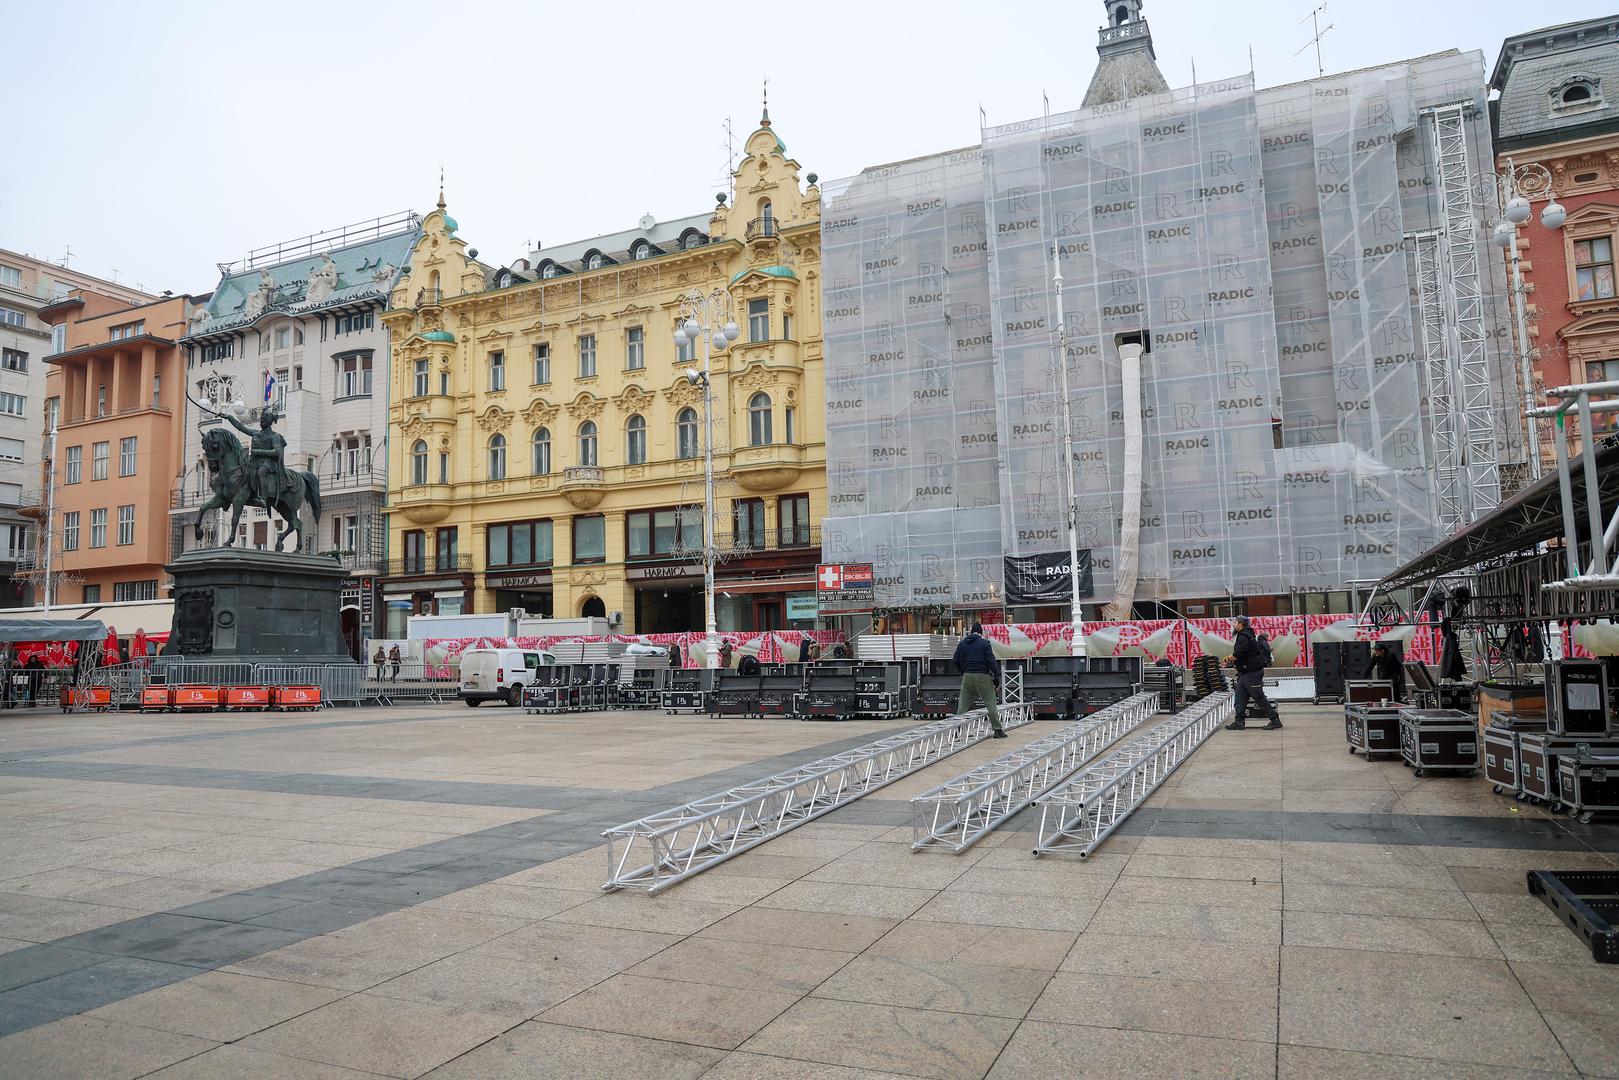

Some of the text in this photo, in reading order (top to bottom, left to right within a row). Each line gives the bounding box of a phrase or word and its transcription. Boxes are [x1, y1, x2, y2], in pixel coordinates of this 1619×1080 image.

[1144, 122, 1186, 137] RADIĆ
[1263, 130, 1308, 148] RADIĆ
[1044, 142, 1083, 157] RADIĆ
[1399, 175, 1432, 188] ADIĆ
[1200, 182, 1244, 198] RADIĆ
[999, 217, 1039, 233] RADIĆ
[1148, 224, 1191, 239] RADIĆ
[952, 240, 987, 255] RADIĆ
[1272, 234, 1317, 251] RADIĆ
[866, 256, 898, 271] RADIĆ
[909, 292, 943, 305] RADIĆ
[1208, 286, 1254, 302] RADIĆ
[826, 305, 860, 318] RADIĆ
[1006, 316, 1045, 332] RADIĆ
[1155, 329, 1199, 344] RADIĆ
[1067, 343, 1097, 357] ADIĆ
[1282, 340, 1327, 356] RADIĆ
[914, 386, 949, 399] RADIĆ
[828, 397, 862, 410] RADIĆ
[1218, 395, 1263, 410] RADIĆ
[1013, 420, 1052, 435] RADIĆ
[961, 432, 997, 444] RADIĆ
[1166, 435, 1210, 451] RADIĆ
[873, 445, 907, 457] RADIĆ
[1284, 471, 1330, 484] RADIĆ
[831, 491, 865, 503] RADIĆ
[916, 484, 952, 496] RADIĆ
[1227, 507, 1272, 521] RADIĆ
[1344, 510, 1392, 525] RADIĆ
[1019, 528, 1058, 540] RADIĆ
[1173, 545, 1217, 560] RADIĆ
[1345, 542, 1394, 555] RADIĆ
[644, 567, 687, 577] HARMICA
[502, 577, 538, 586] HARMICA
[914, 582, 950, 595] RADIĆ
[962, 587, 1002, 602] RADIĆ
